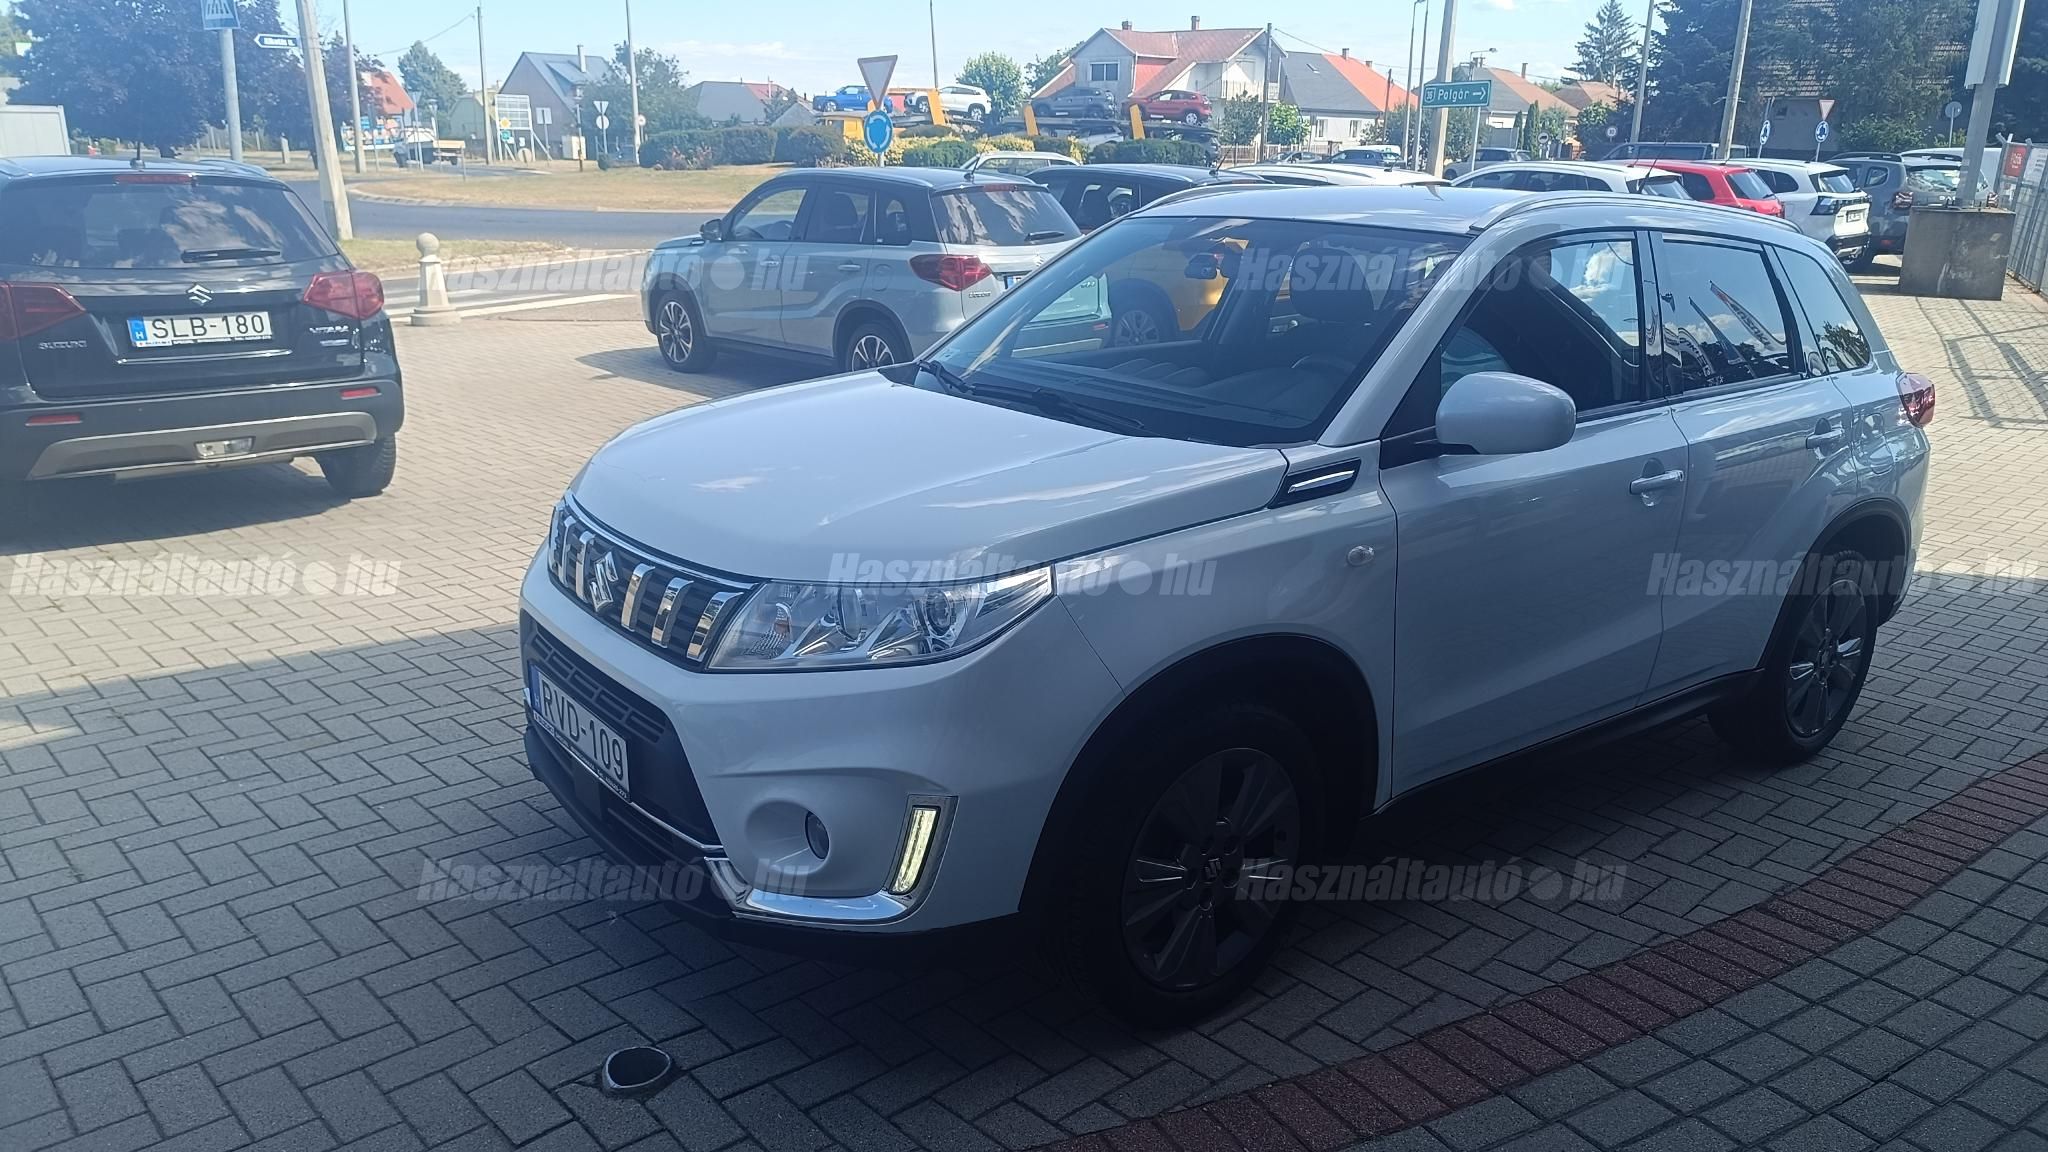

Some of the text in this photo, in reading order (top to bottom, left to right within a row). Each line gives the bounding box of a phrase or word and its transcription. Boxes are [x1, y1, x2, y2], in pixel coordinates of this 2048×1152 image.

[1437, 88, 1470, 103] Polgár
[135, 332, 145, 340] H
[152, 315, 265, 339] SLB-180
[541, 680, 624, 781] RVD-109
